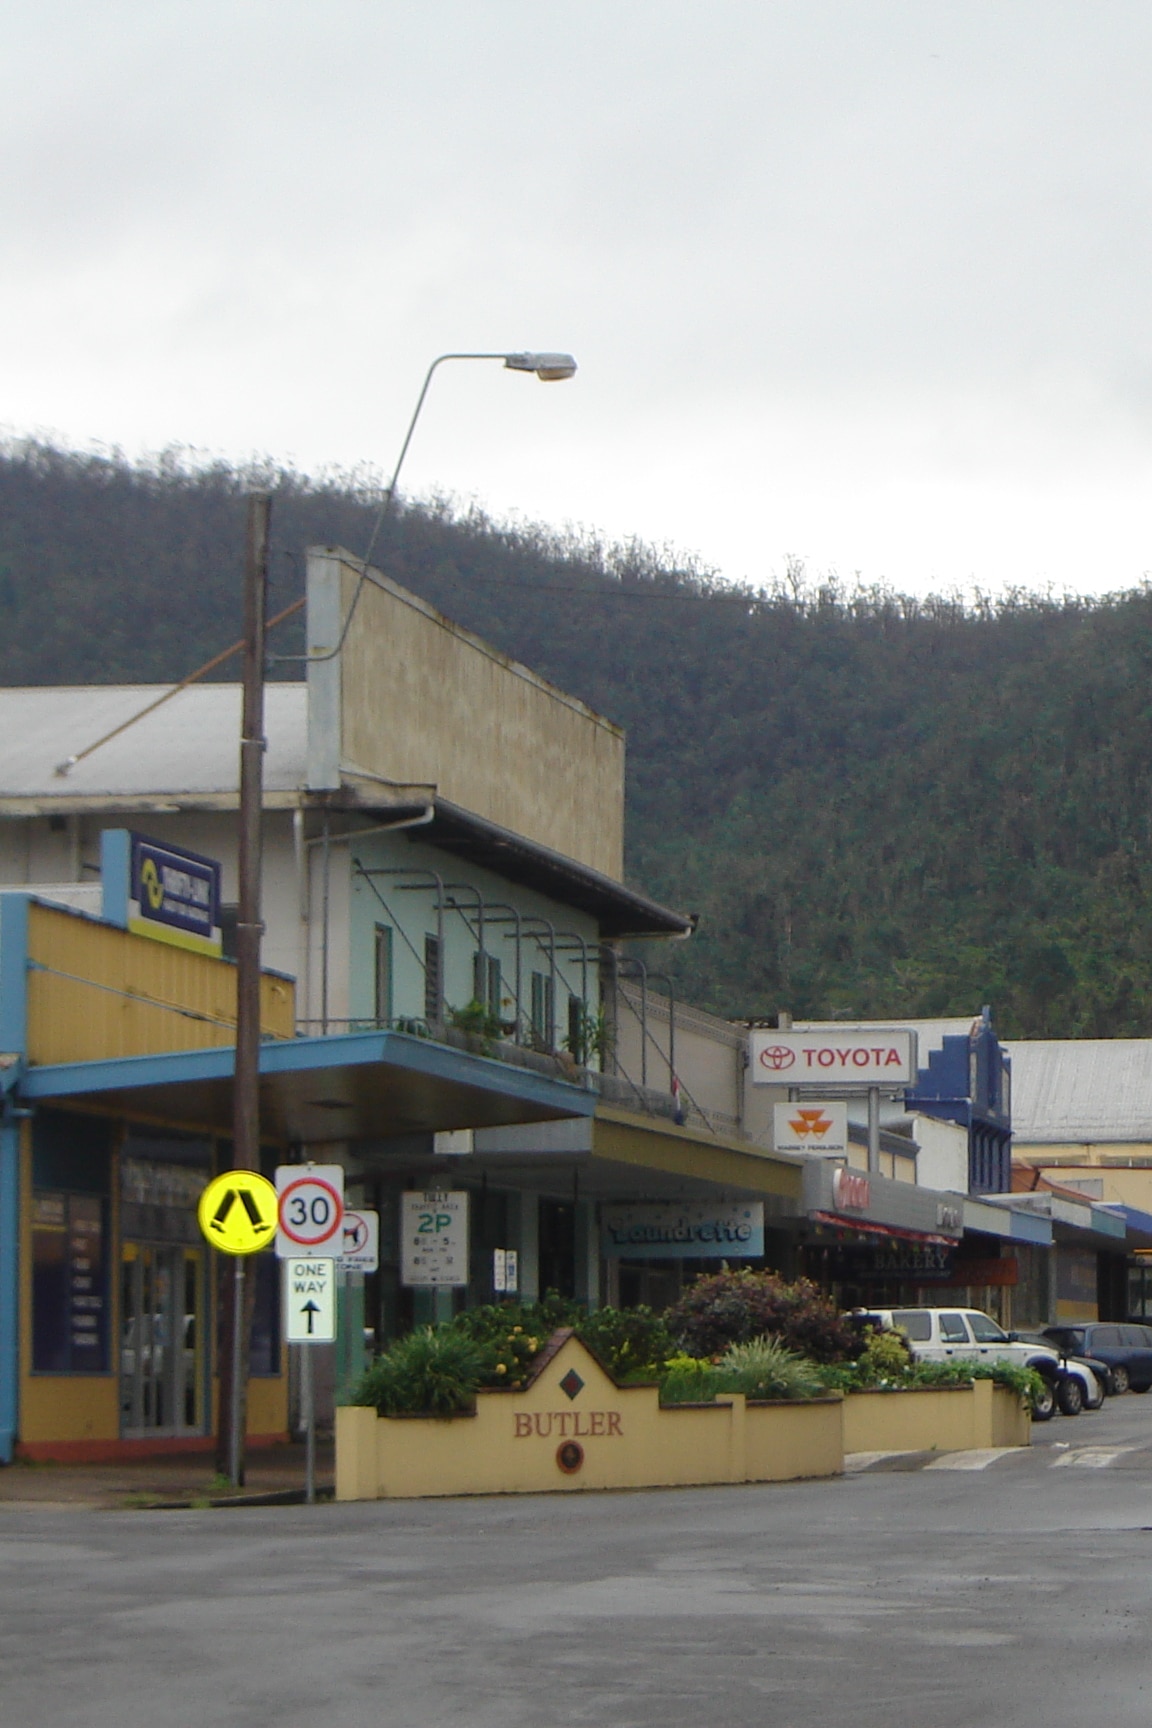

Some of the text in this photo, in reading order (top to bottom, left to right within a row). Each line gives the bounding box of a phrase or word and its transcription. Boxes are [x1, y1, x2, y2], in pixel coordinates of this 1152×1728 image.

[802, 1048, 902, 1067] TOYOTA
[290, 1196, 330, 1226] 30
[418, 1213, 452, 1233] 2P
[875, 1252, 950, 1269] BAKERY
[294, 1264, 326, 1277] ONE
[293, 1281, 327, 1294] WAY
[514, 1411, 624, 1438] BUTLER
